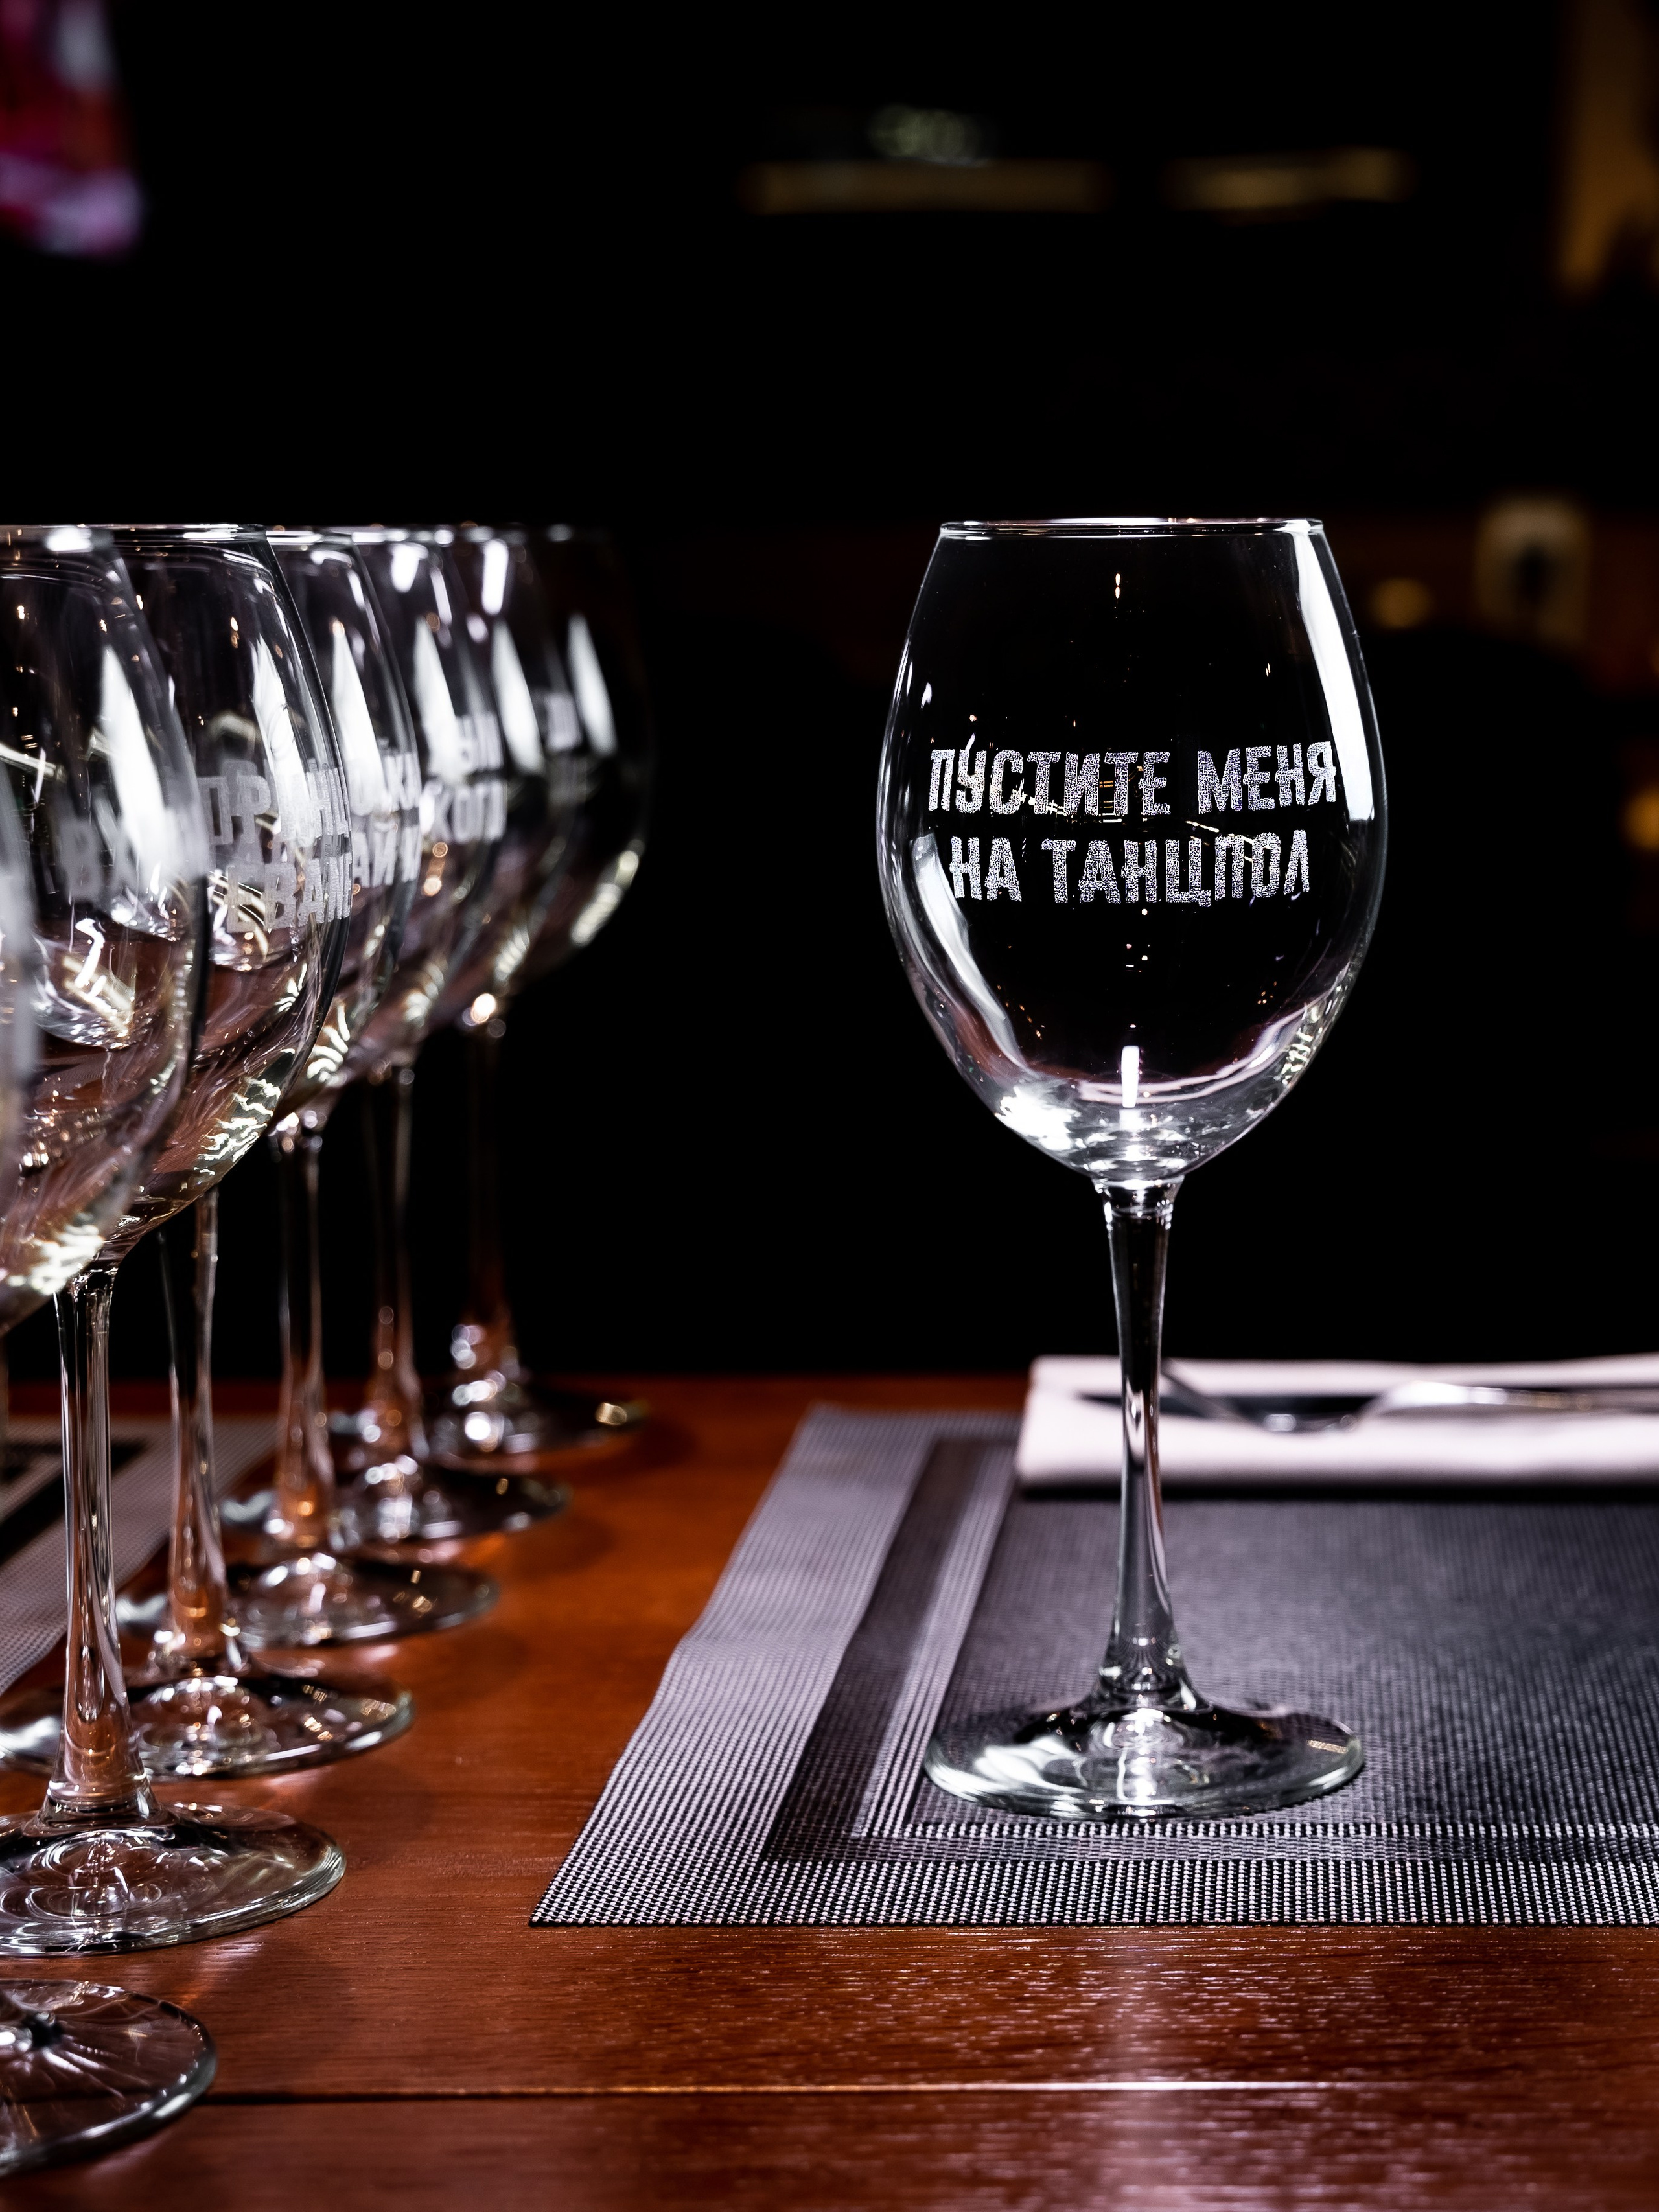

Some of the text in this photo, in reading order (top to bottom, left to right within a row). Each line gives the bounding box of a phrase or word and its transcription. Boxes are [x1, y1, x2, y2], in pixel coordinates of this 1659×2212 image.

[929, 741, 1336, 815] ПУСТИТЕ МЕНЯ
[949, 829, 1310, 907] НА ТАНЦПОЛ
